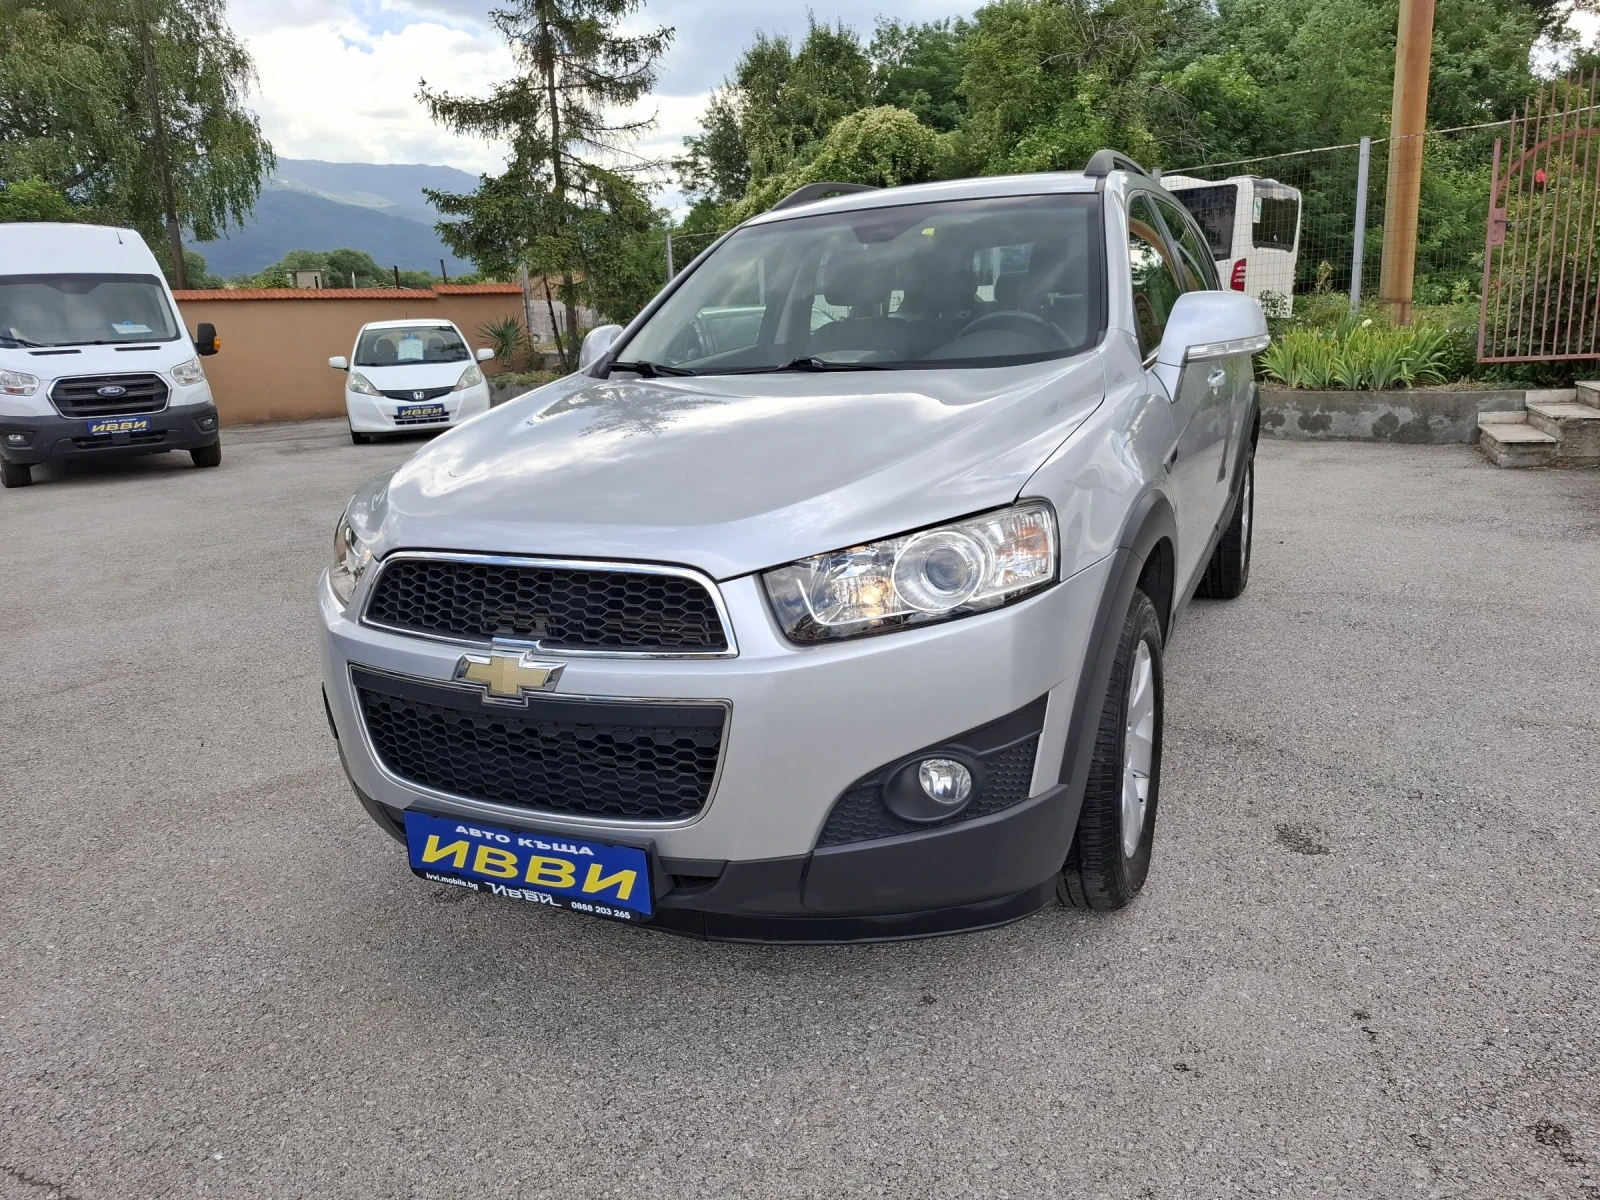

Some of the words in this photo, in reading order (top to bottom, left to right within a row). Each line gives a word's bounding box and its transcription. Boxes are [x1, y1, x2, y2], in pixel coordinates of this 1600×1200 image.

[401, 407, 443, 416] ИВВИ
[91, 420, 147, 432] ИВВИ
[455, 825, 511, 843] АВТО
[517, 838, 595, 856] КЪЩА
[421, 834, 638, 900] ИВВИ
[571, 901, 593, 912] 0888
[595, 906, 612, 915] 203
[613, 910, 631, 919] 265
